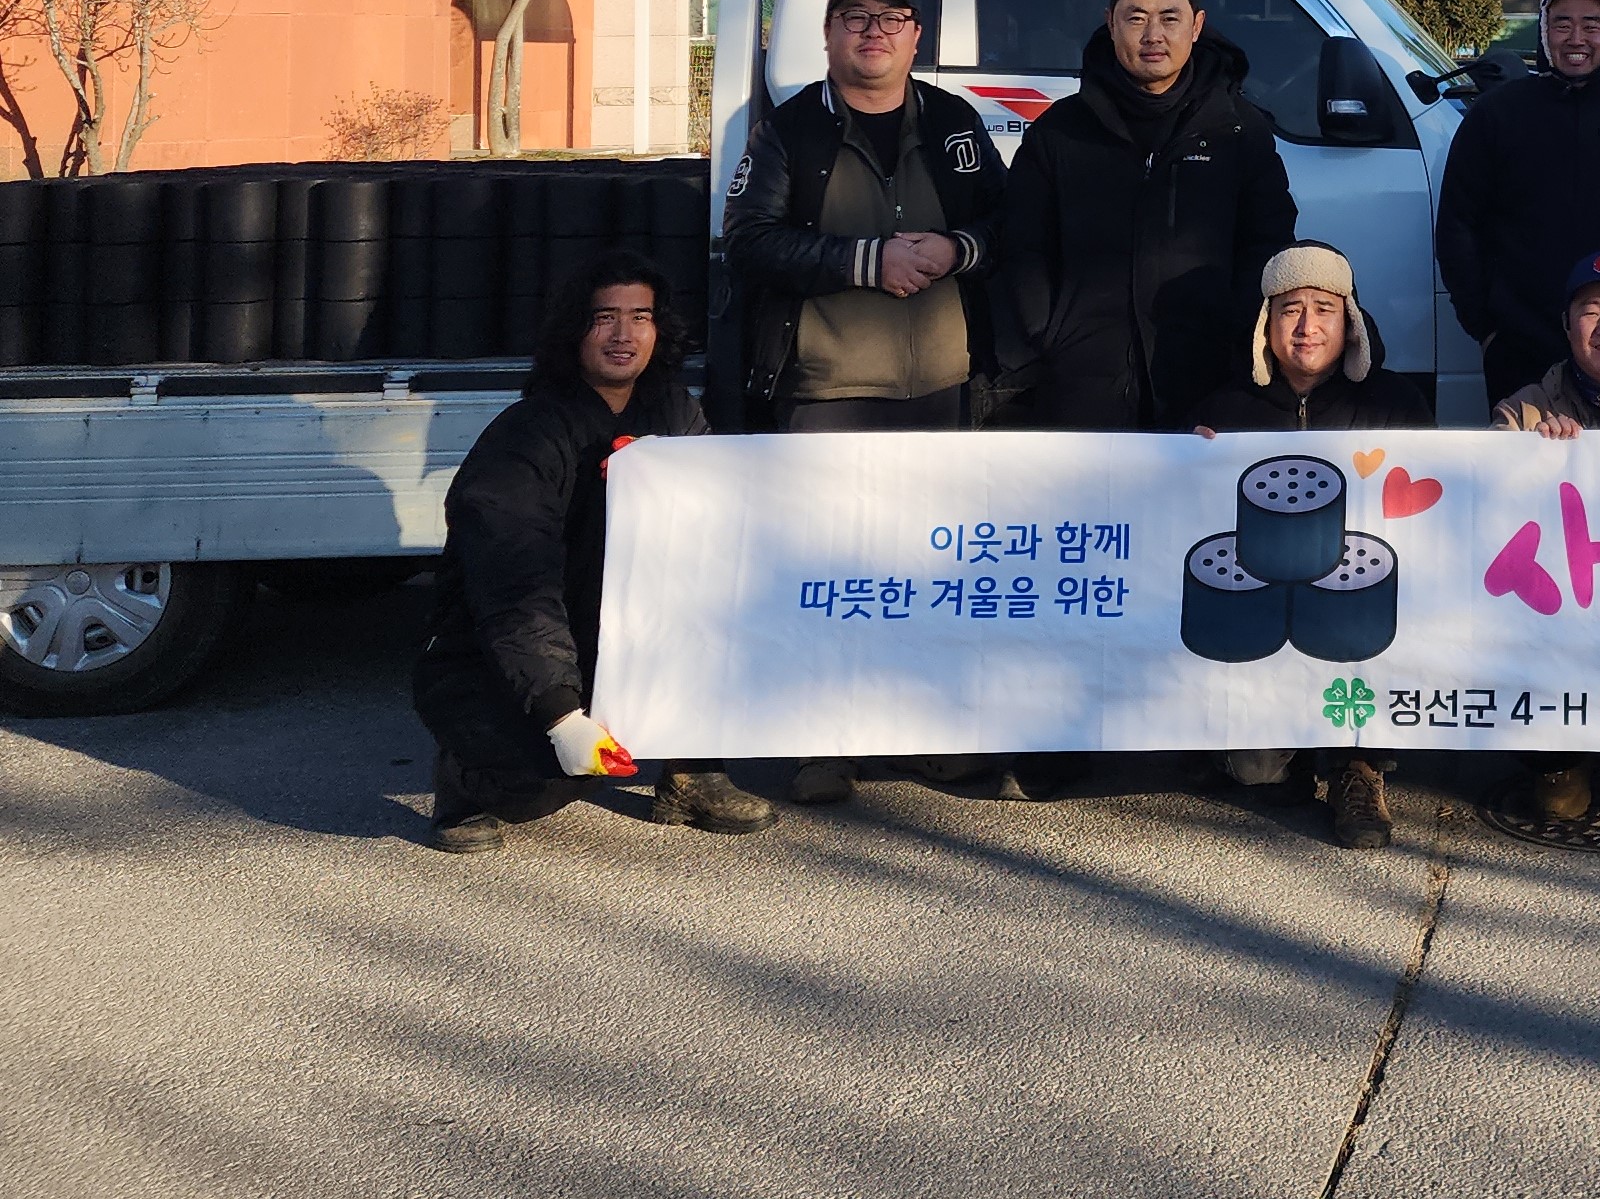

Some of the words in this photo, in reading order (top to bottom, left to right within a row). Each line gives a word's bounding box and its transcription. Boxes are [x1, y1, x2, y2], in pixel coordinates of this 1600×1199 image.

[930, 522, 1043, 564] 이웃과
[1055, 520, 1131, 564] 함께
[800, 576, 917, 619] 따뜻한
[930, 576, 1040, 619] 겨울을
[1053, 574, 1130, 618] 위한
[1388, 688, 1497, 729] 정선군
[1510, 691, 1589, 727] 4-H
